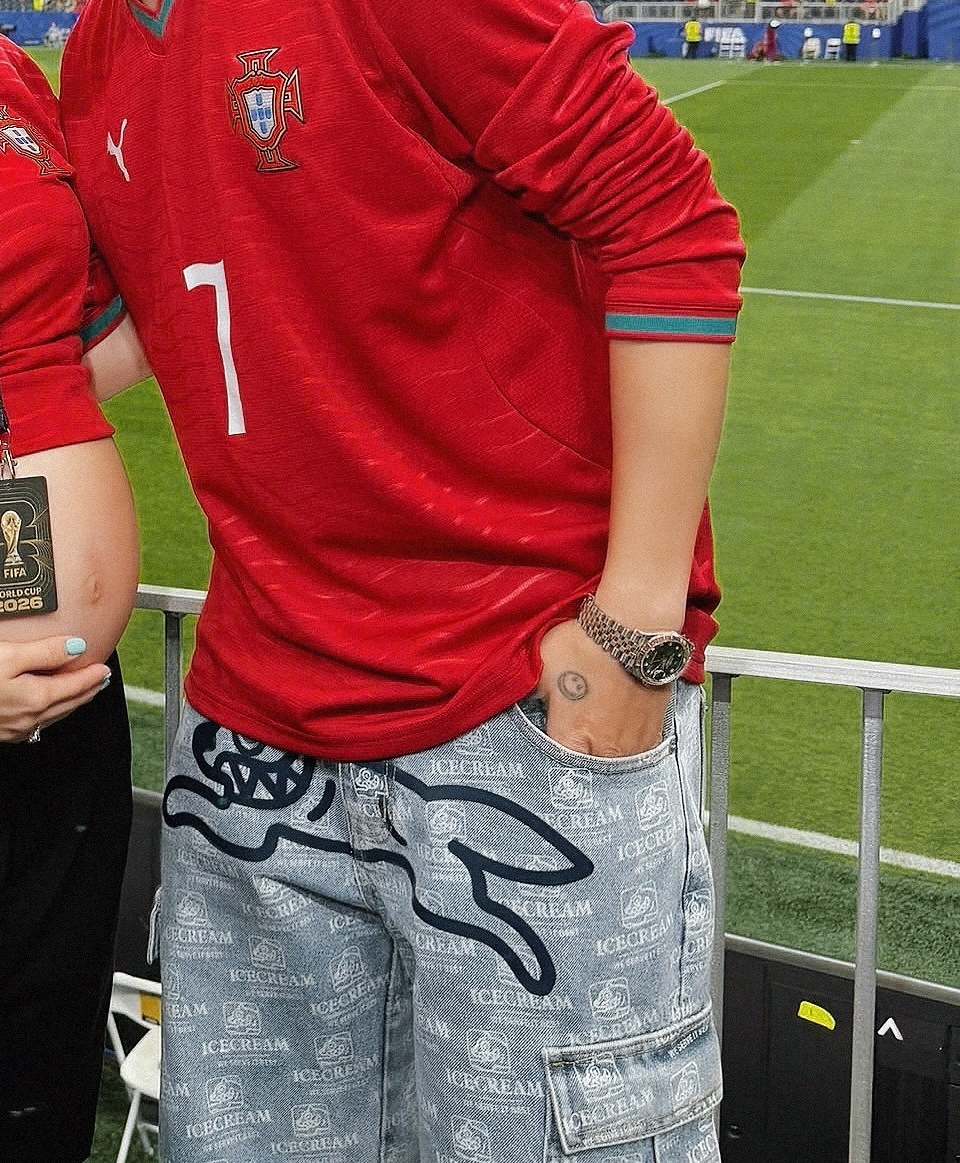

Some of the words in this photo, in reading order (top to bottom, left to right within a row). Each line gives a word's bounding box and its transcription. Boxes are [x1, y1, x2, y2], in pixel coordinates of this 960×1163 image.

[182, 259, 246, 436] 7
[3, 568, 27, 579] FIFA
[24, 586, 42, 596] CUP
[429, 759, 525, 779] ICECREAM
[230, 968, 317, 988] ICECREAM
[469, 988, 574, 1011] ICECREAM
[201, 1037, 291, 1057] ICECREAM
[445, 1067, 546, 1098] ICECREAM
[186, 1108, 273, 1140] ICECREAM
[270, 1131, 360, 1155] ICECREAM
